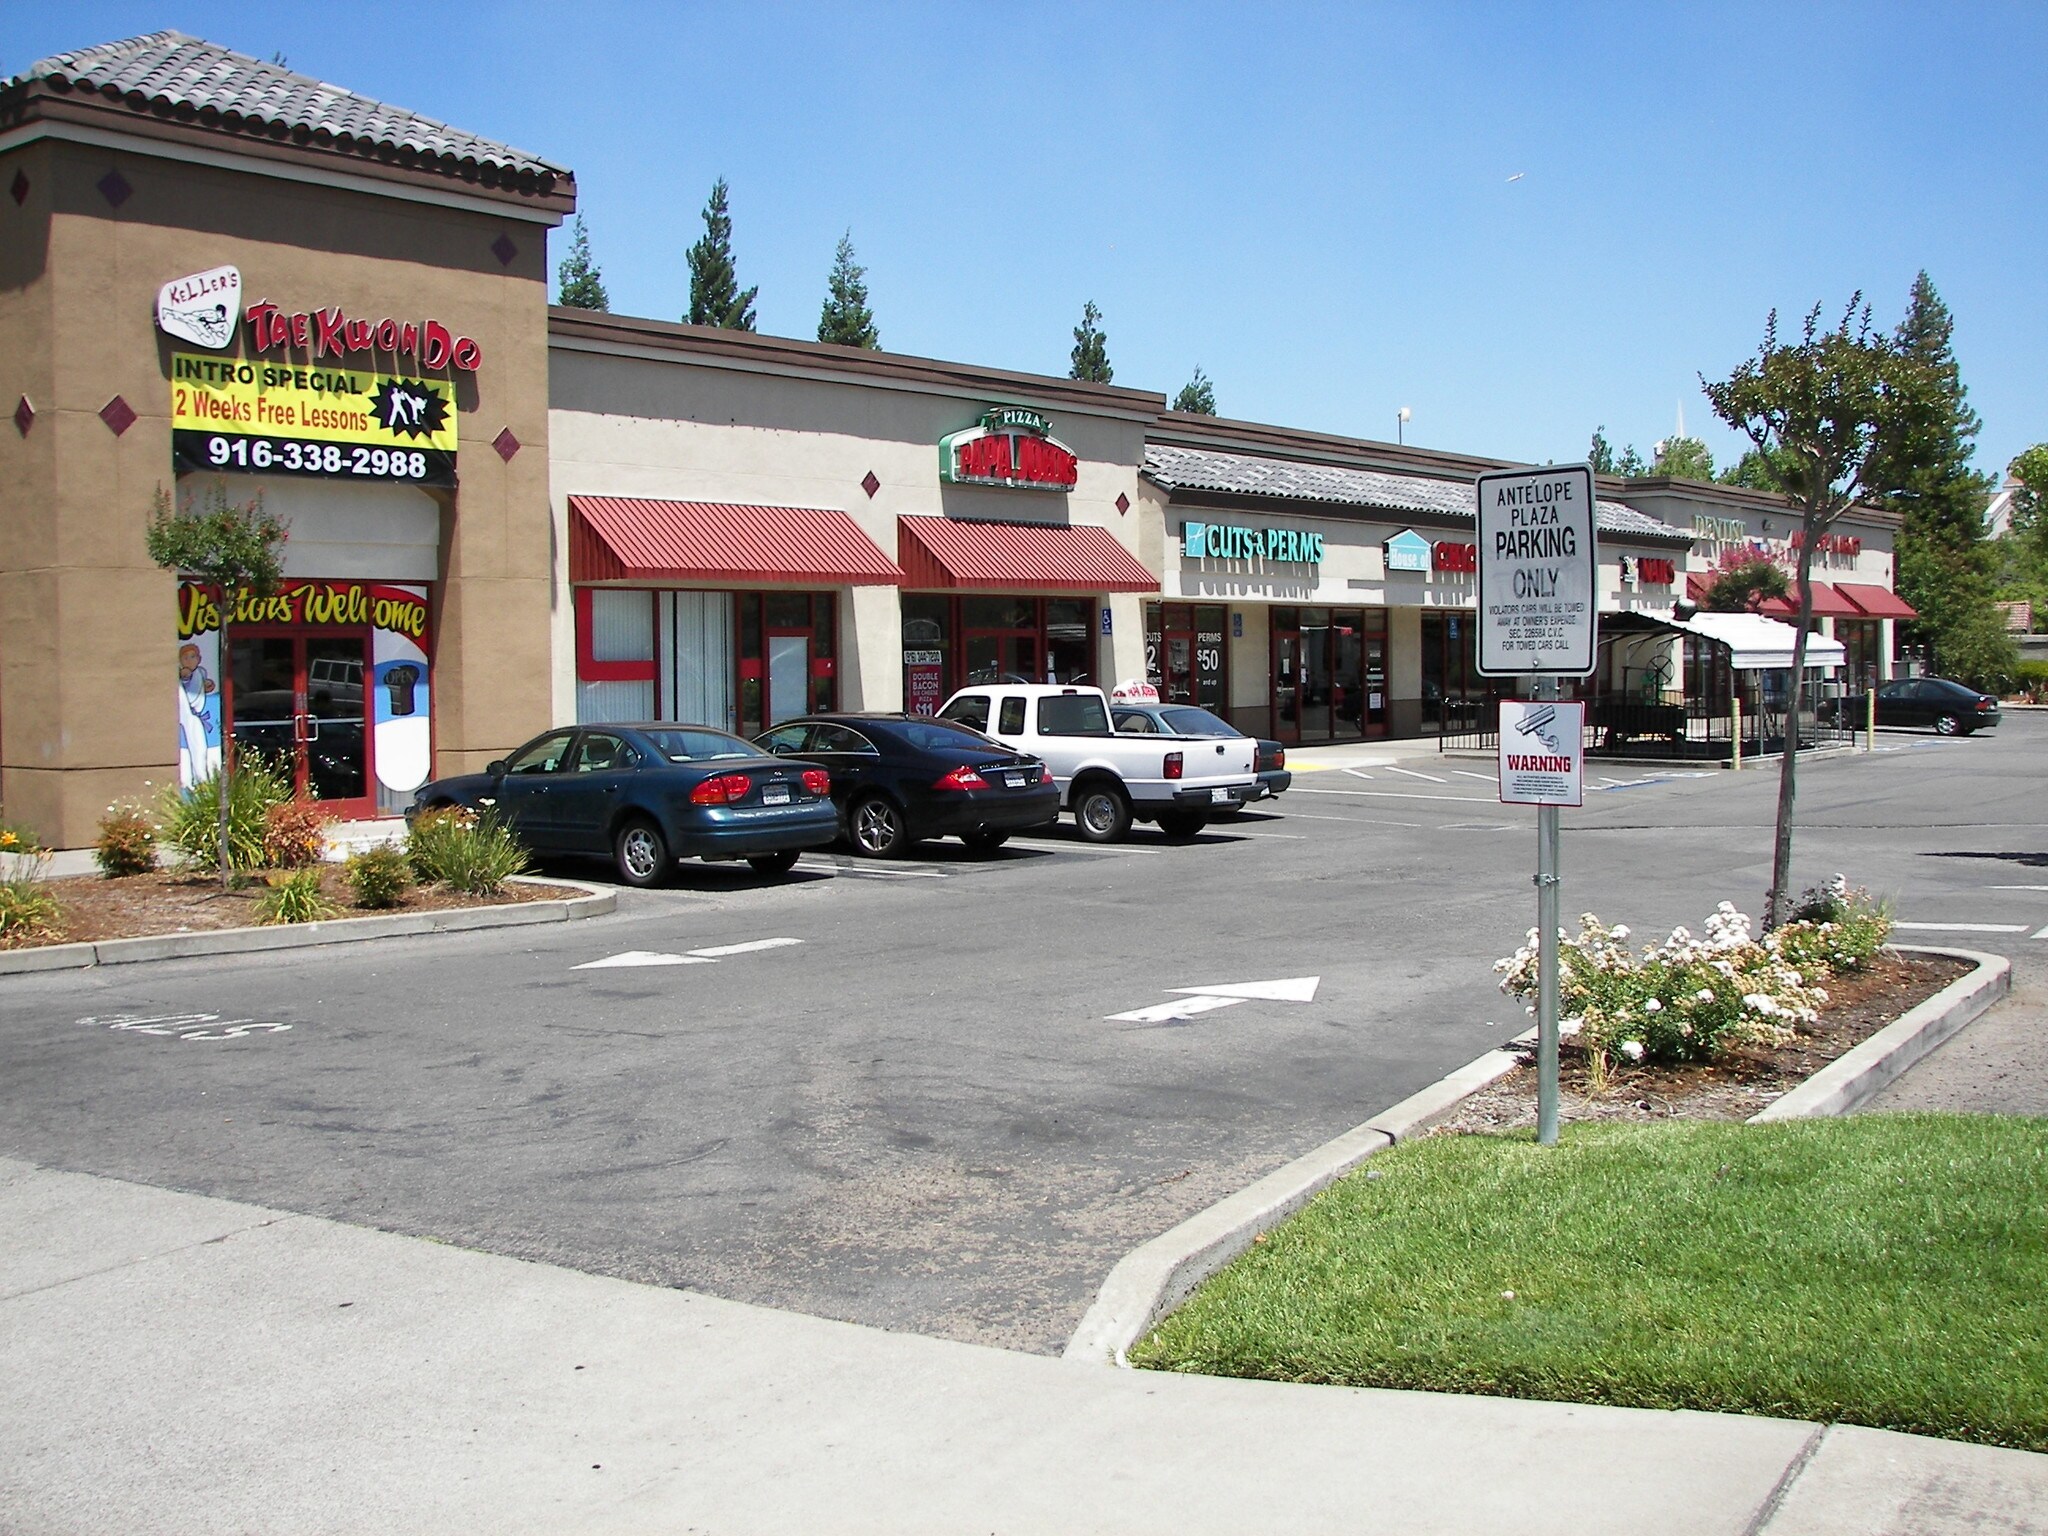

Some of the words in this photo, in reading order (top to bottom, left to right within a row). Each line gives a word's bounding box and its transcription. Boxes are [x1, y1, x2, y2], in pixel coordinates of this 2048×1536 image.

[176, 358, 254, 385] INTRO
[263, 367, 363, 395] SPECIAL
[176, 389, 186, 416] 2
[194, 391, 251, 422] Weeks
[257, 397, 296, 426] Free
[301, 401, 368, 432] Lessons
[1003, 410, 1041, 426] PIZZA
[208, 437, 427, 479] 916-338-2988
[959, 434, 1012, 479] PAPA
[1497, 481, 1573, 507] ANTELOPE
[1511, 505, 1559, 527] PLAZA
[1693, 514, 1746, 542] DENTIST
[1206, 524, 1254, 559] CUTS
[1256, 531, 1266, 556] &
[1267, 528, 1324, 564] PERMS
[1496, 526, 1576, 560] PARKING
[1391, 548, 1417, 567] House
[1421, 549, 1432, 568] of
[1513, 567, 1560, 599] ONLY
[1489, 604, 1519, 615] VIOLATORS
[1521, 604, 1537, 614] CARS
[1540, 603, 1552, 613] WILL
[1554, 603, 1562, 613] BE
[1564, 602, 1585, 613] TOWED
[1497, 616, 1512, 627] AWAY
[1513, 616, 1520, 626] AT
[1550, 614, 1576, 625] EXPENSE
[1197, 632, 1222, 643] PERMS
[1502, 640, 1514, 651] FOR
[1516, 640, 1536, 650] TOWED
[1537, 640, 1553, 650] CARS
[1555, 639, 1569, 650] CALL
[1197, 649, 1219, 671] $50
[385, 669, 414, 684] OPEN
[912, 672, 938, 681] DOUBLE
[912, 681, 938, 690] BACON
[1507, 755, 1571, 773] WARNING
